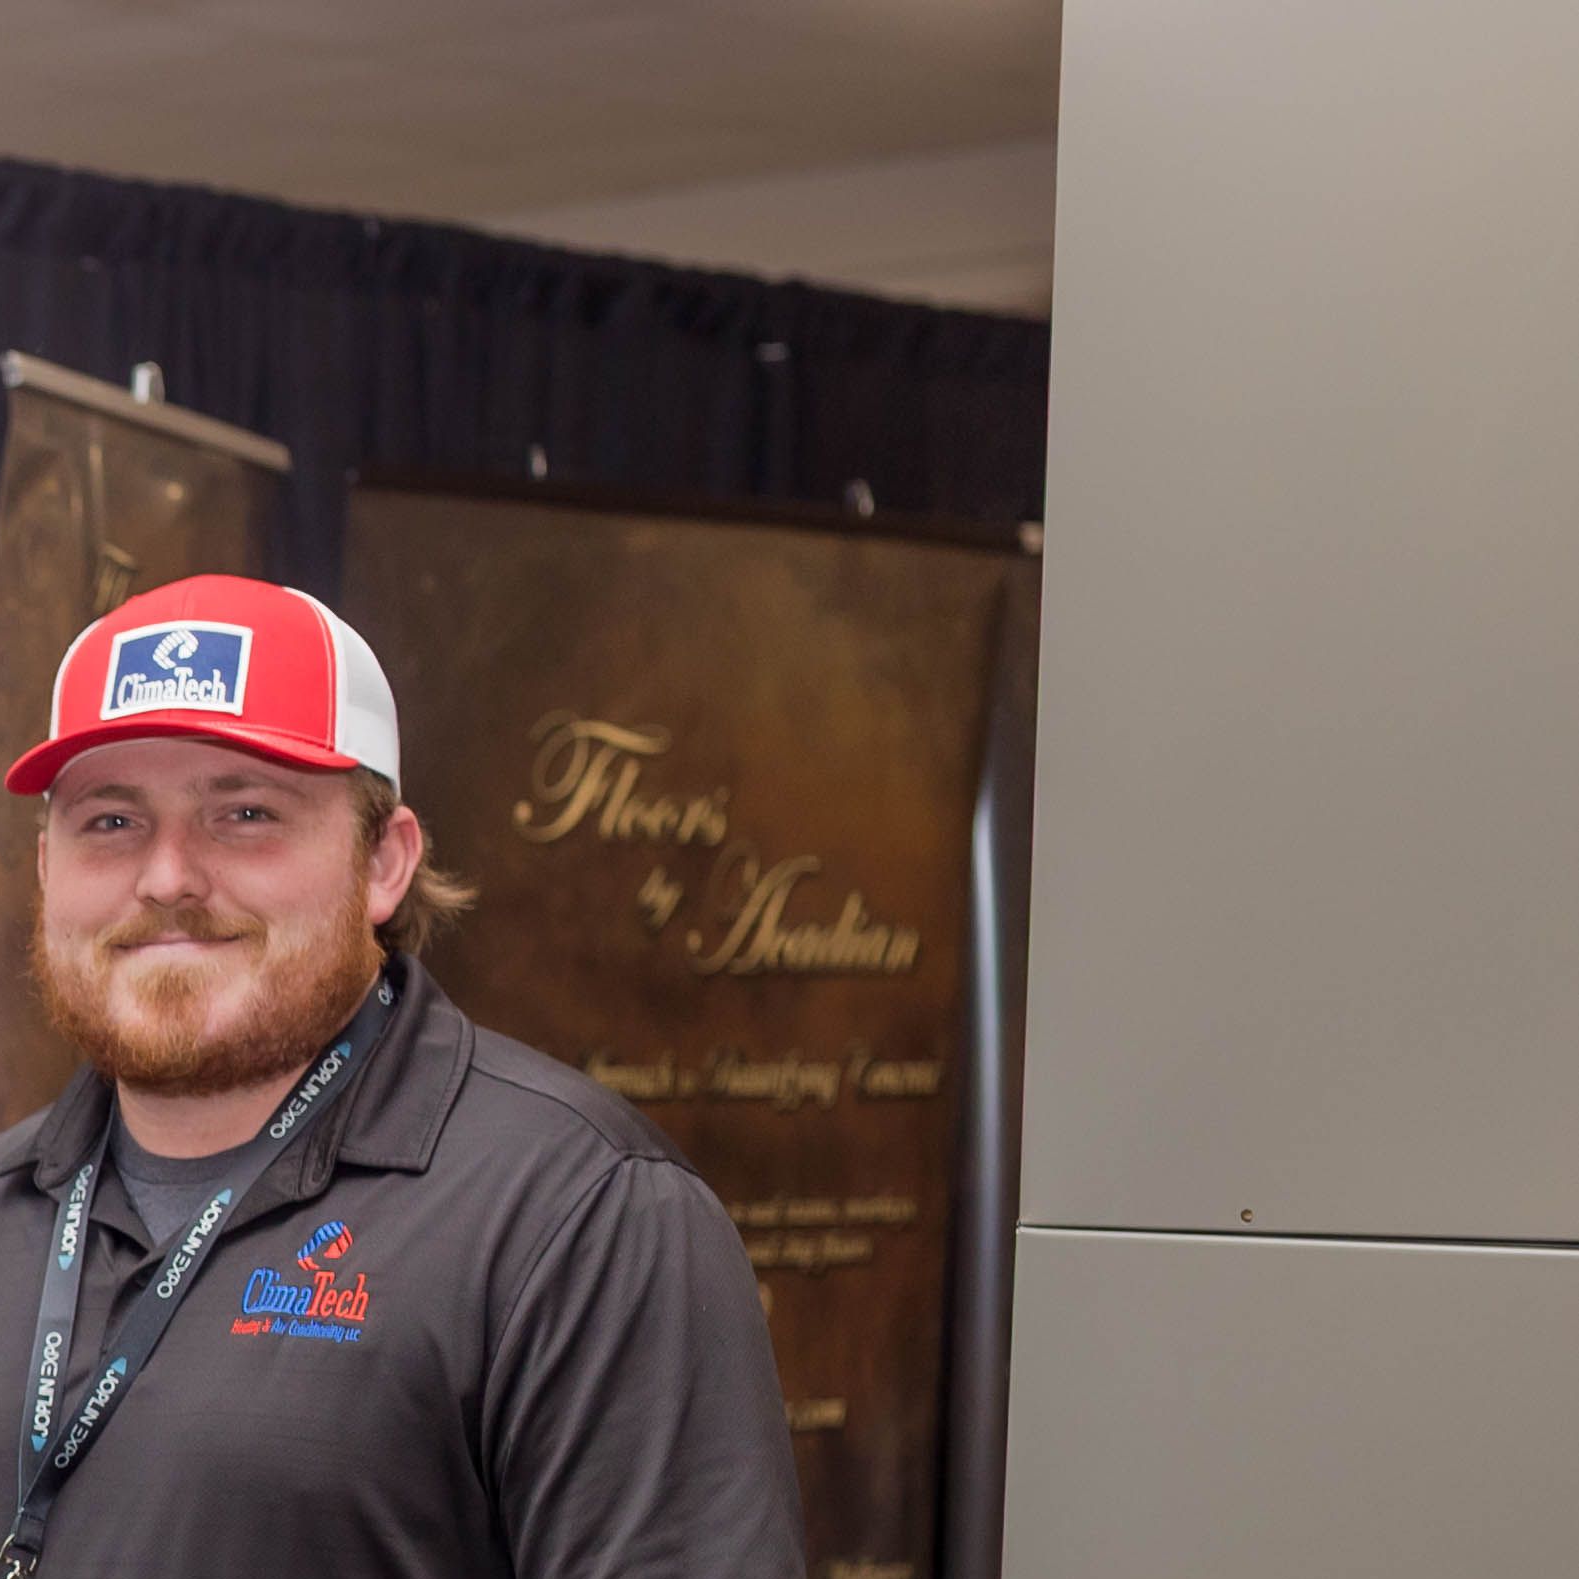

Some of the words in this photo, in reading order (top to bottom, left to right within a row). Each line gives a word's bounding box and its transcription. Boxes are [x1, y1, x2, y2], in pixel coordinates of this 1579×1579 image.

[117, 666, 228, 709] ClimaTech
[298, 1049, 342, 1103] JOPLIN
[269, 1097, 308, 1139] EXPO
[61, 1201, 83, 1257] JOPLIN
[182, 1199, 223, 1256] JOPLIN
[156, 1254, 192, 1299] EXPO
[243, 1267, 369, 1322] ClimaTech
[40, 1331, 63, 1377] EXPO
[33, 1378, 57, 1439] JOPLIN
[79, 1368, 120, 1427] JOPLIN
[54, 1423, 89, 1470] EXPO
